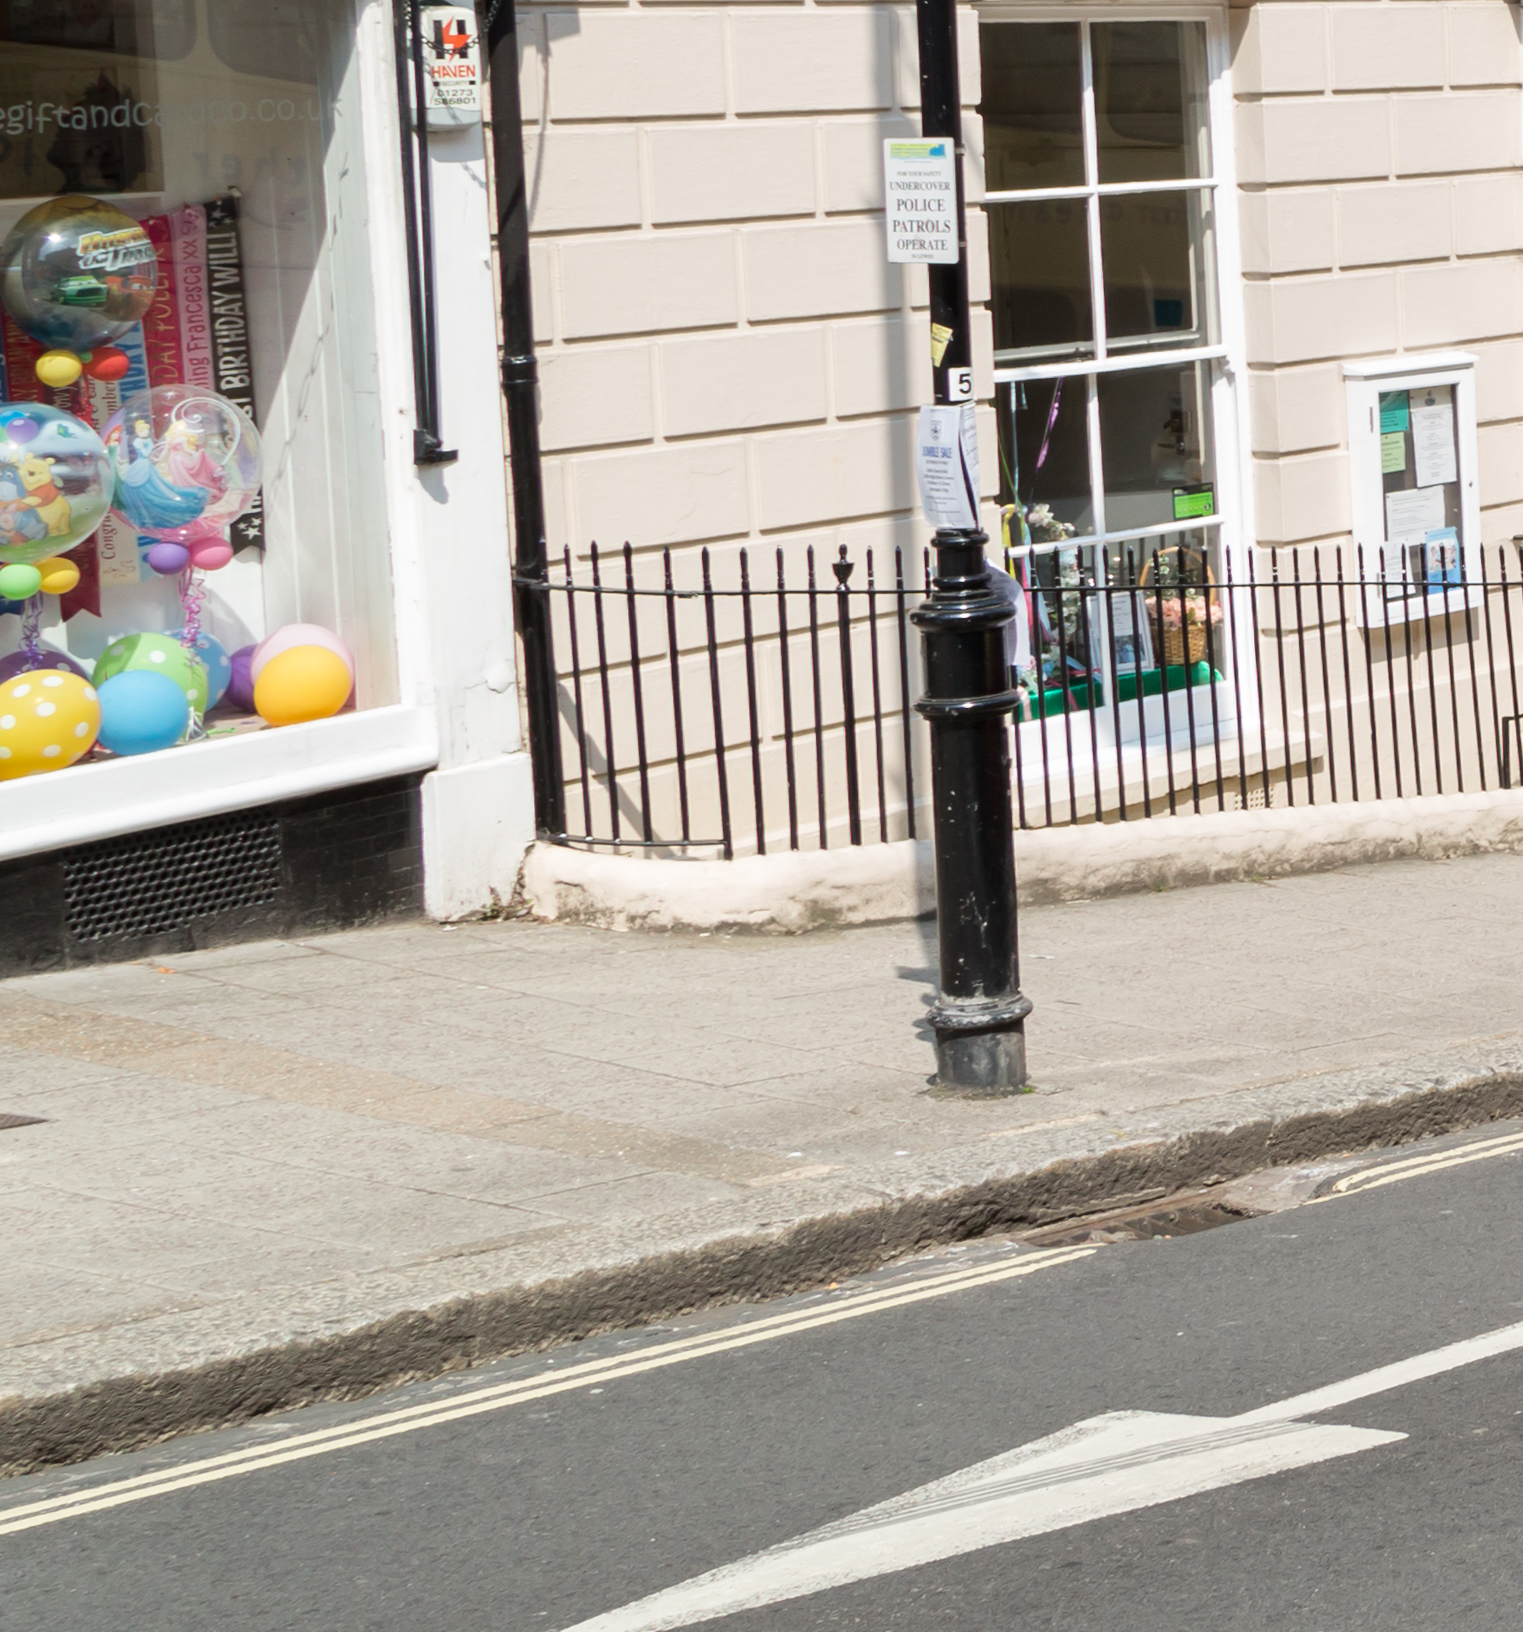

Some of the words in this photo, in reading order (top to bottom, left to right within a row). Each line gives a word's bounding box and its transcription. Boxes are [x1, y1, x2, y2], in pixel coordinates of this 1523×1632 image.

[431, 64, 475, 79] HAVEN
[437, 88, 473, 97] 01273
[889, 181, 951, 191] UNDERCOVER
[896, 198, 946, 212] POLICE
[892, 219, 952, 233] PATROLS
[896, 239, 948, 250] OPERATE
[183, 265, 208, 353] Francesca
[211, 290, 251, 391] BIRTHDAY
[958, 373, 972, 394] 5
